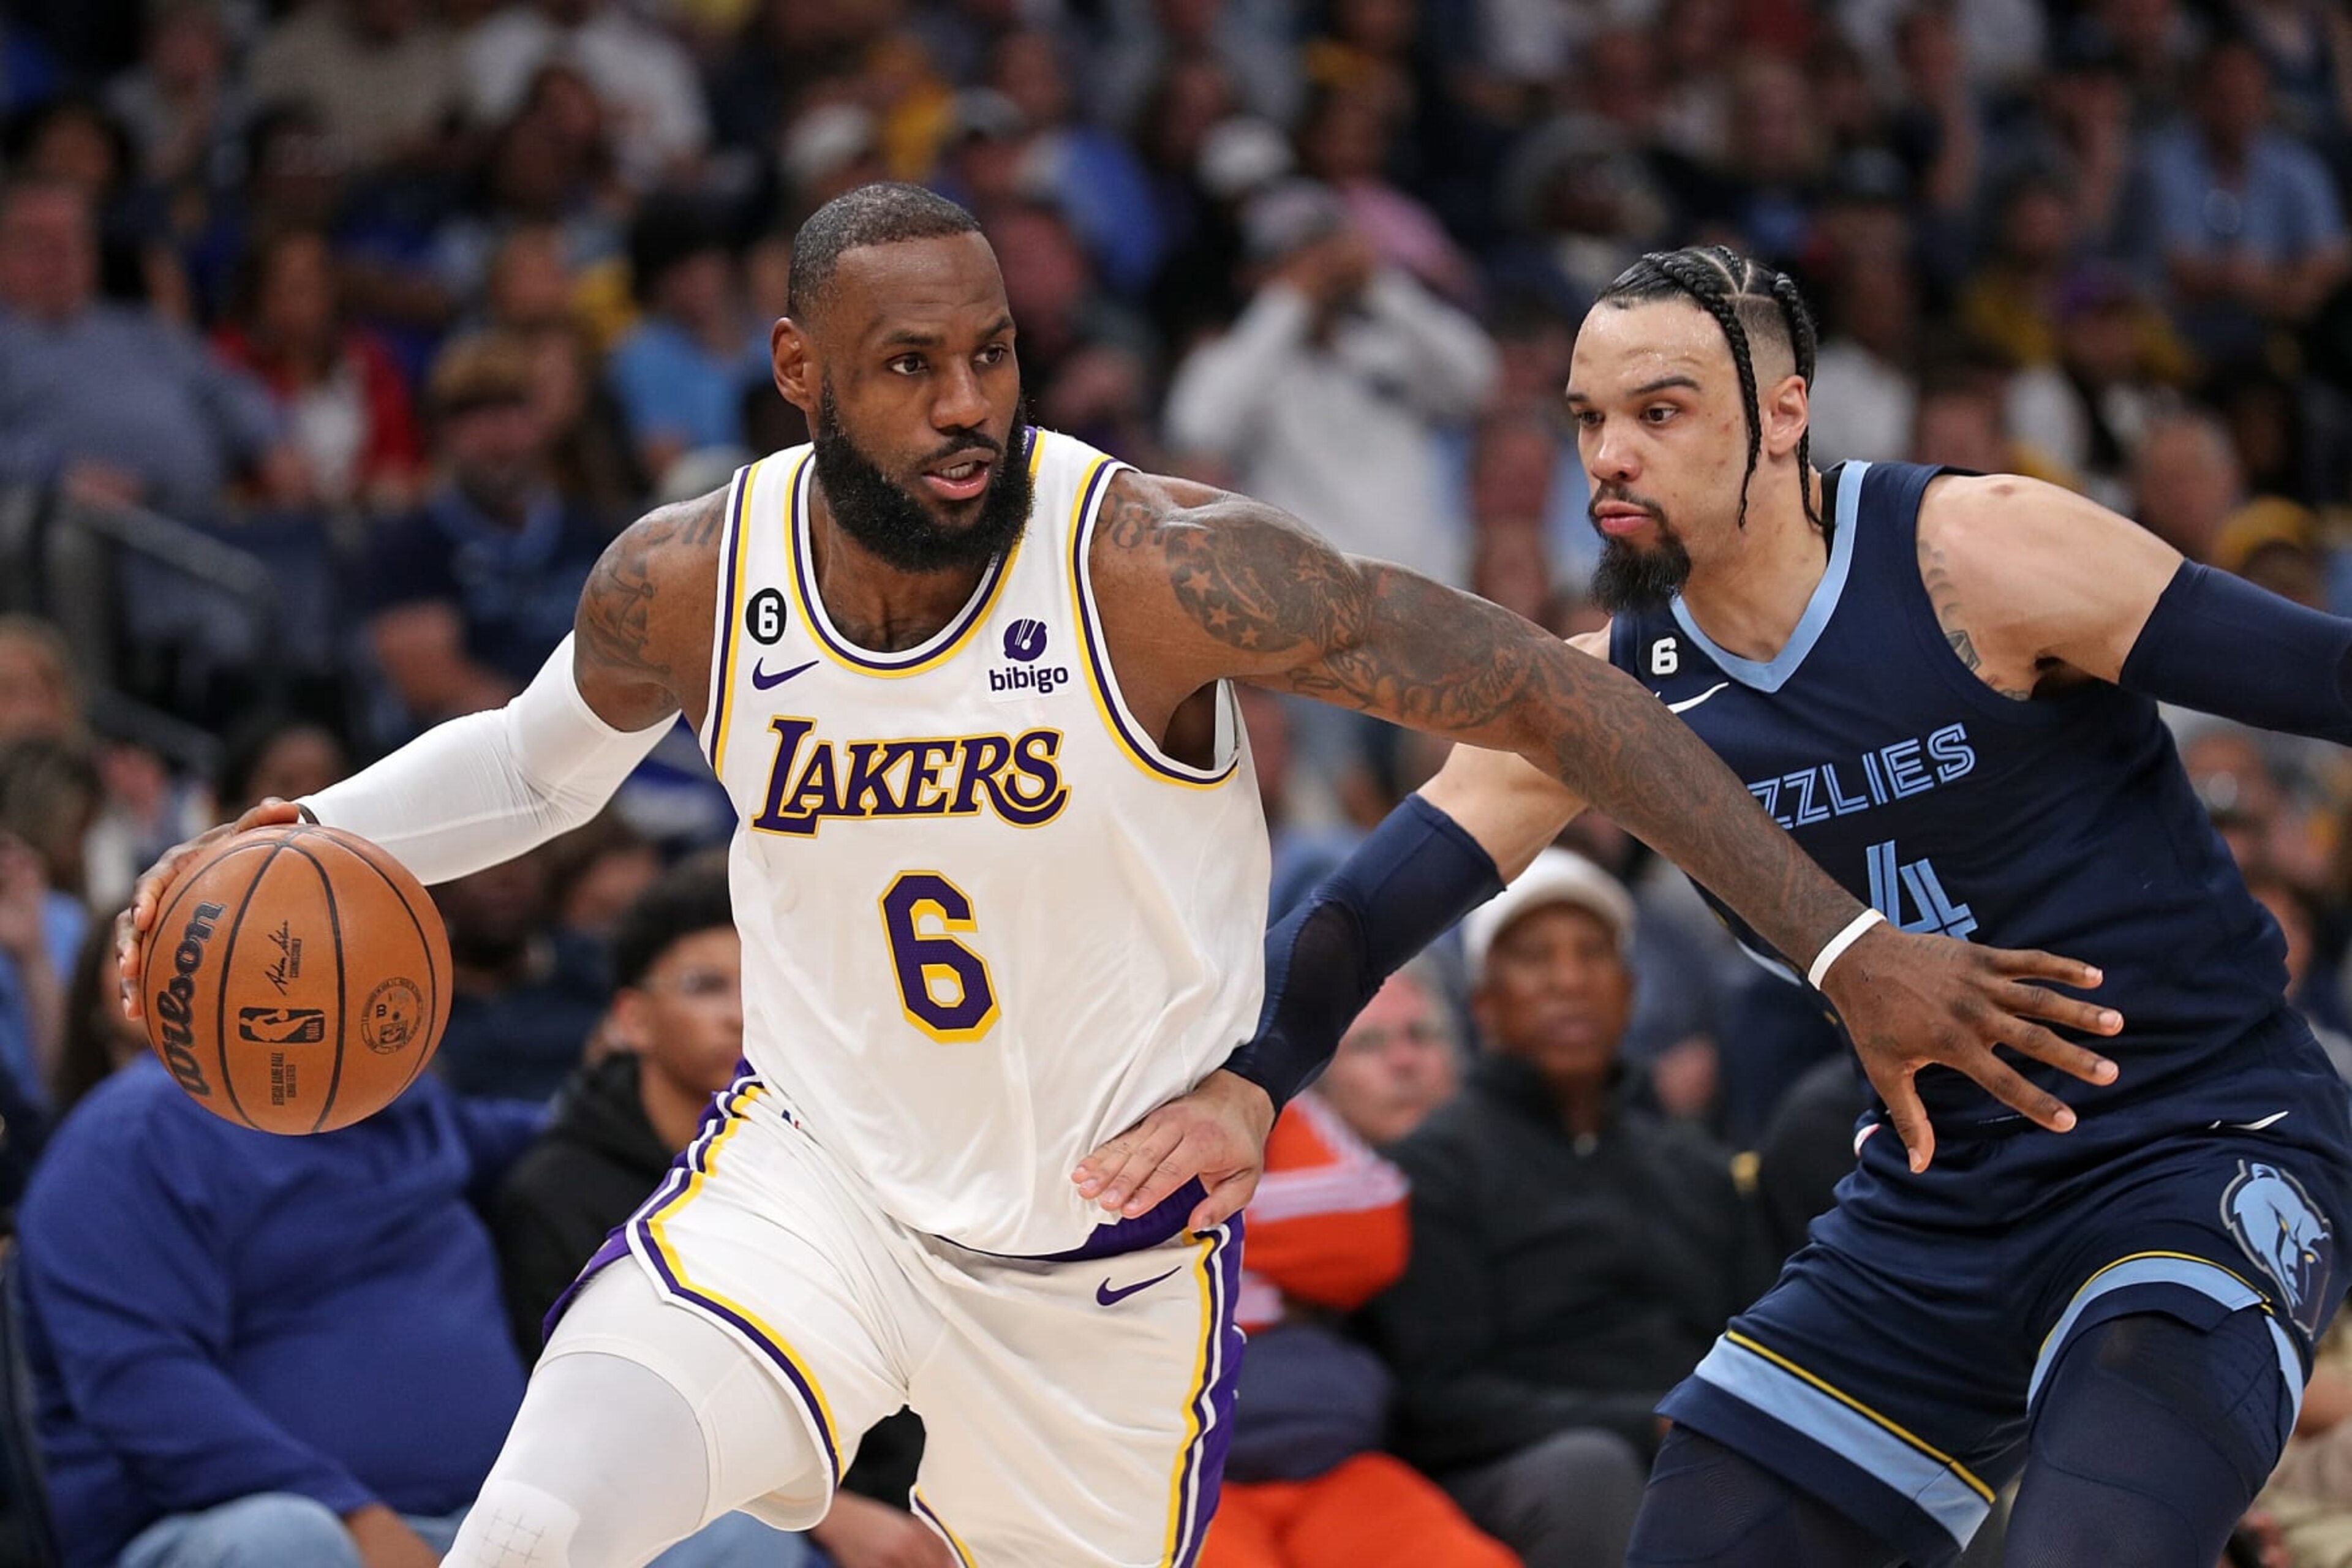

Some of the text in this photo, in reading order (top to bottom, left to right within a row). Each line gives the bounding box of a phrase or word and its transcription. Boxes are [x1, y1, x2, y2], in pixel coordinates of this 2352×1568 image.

[758, 596, 779, 638] 6
[989, 665, 1069, 694] bibigo
[1651, 636, 1678, 674] 6
[752, 714, 1072, 839] LAKERS
[1866, 840, 1978, 941] 4
[878, 869, 1001, 1045] 6
